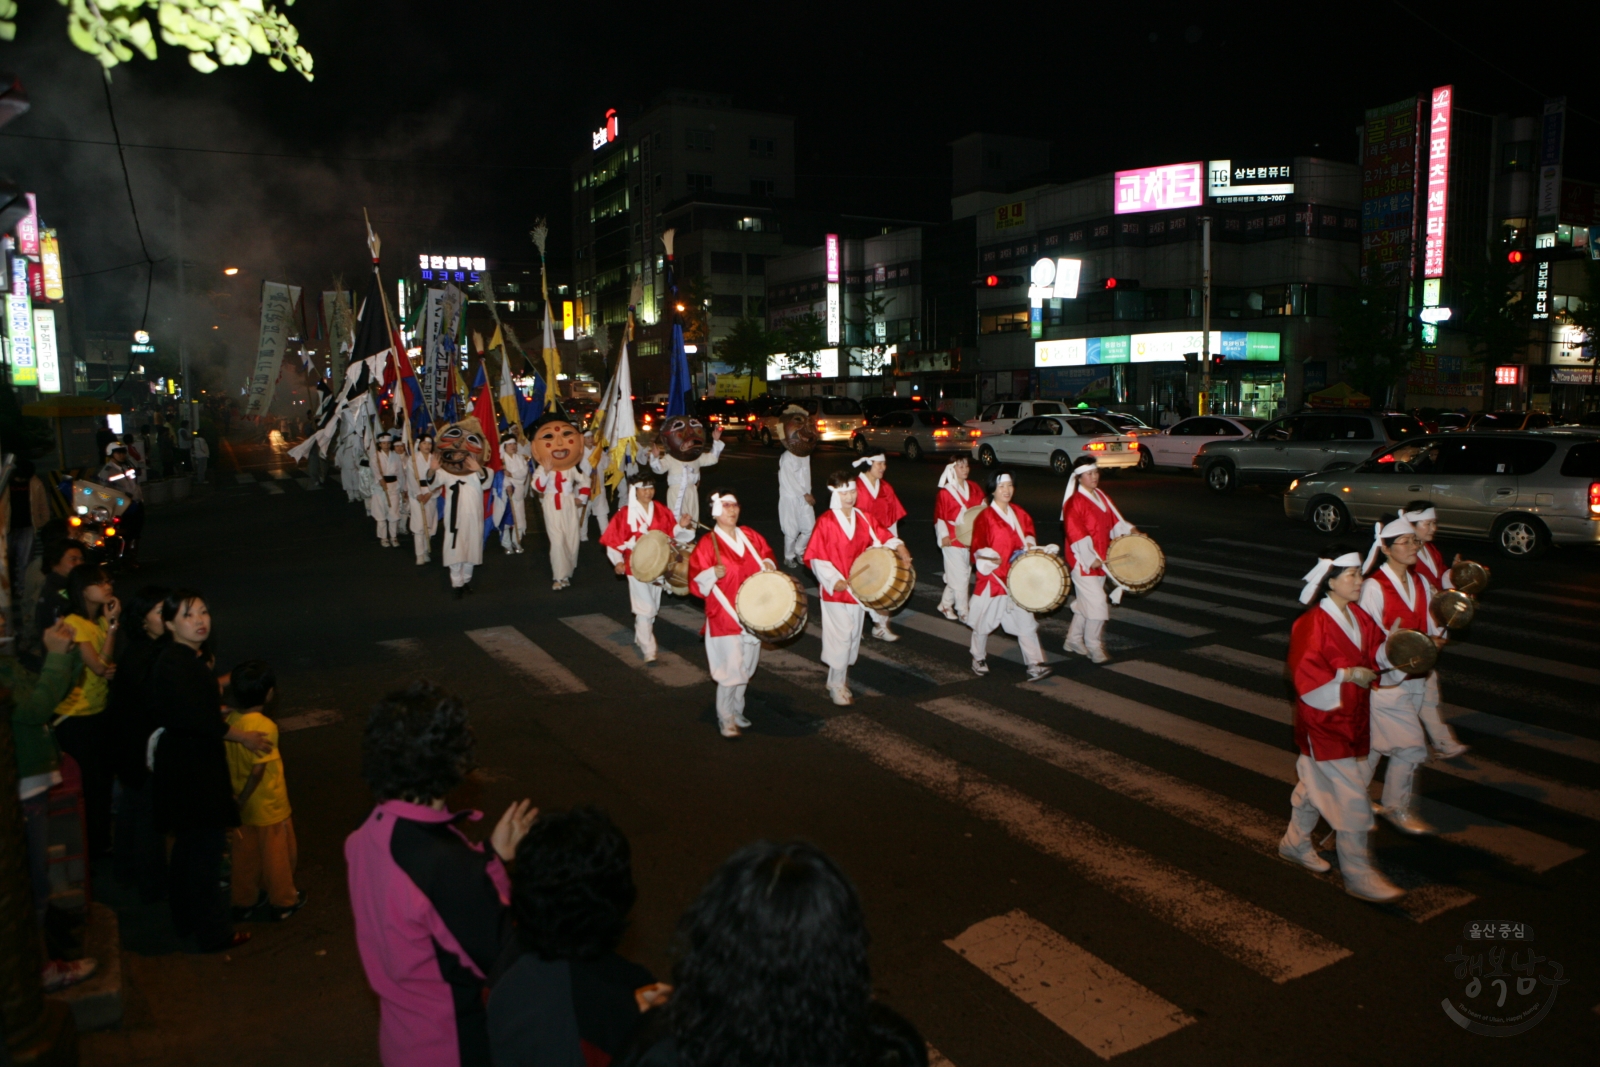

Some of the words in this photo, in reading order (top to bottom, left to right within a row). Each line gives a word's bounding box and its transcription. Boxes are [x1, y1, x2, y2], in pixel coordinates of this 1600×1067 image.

[593, 109, 619, 150] 눈높이
[1367, 111, 1413, 144] 골프
[1212, 170, 1228, 182] TG
[1235, 166, 1290, 179] 삼보컴퓨터
[1428, 111, 1447, 236] 스포츠센타
[1118, 164, 1200, 211] 교차로
[998, 203, 1022, 220] 임대
[421, 270, 481, 282] 파크랜드
